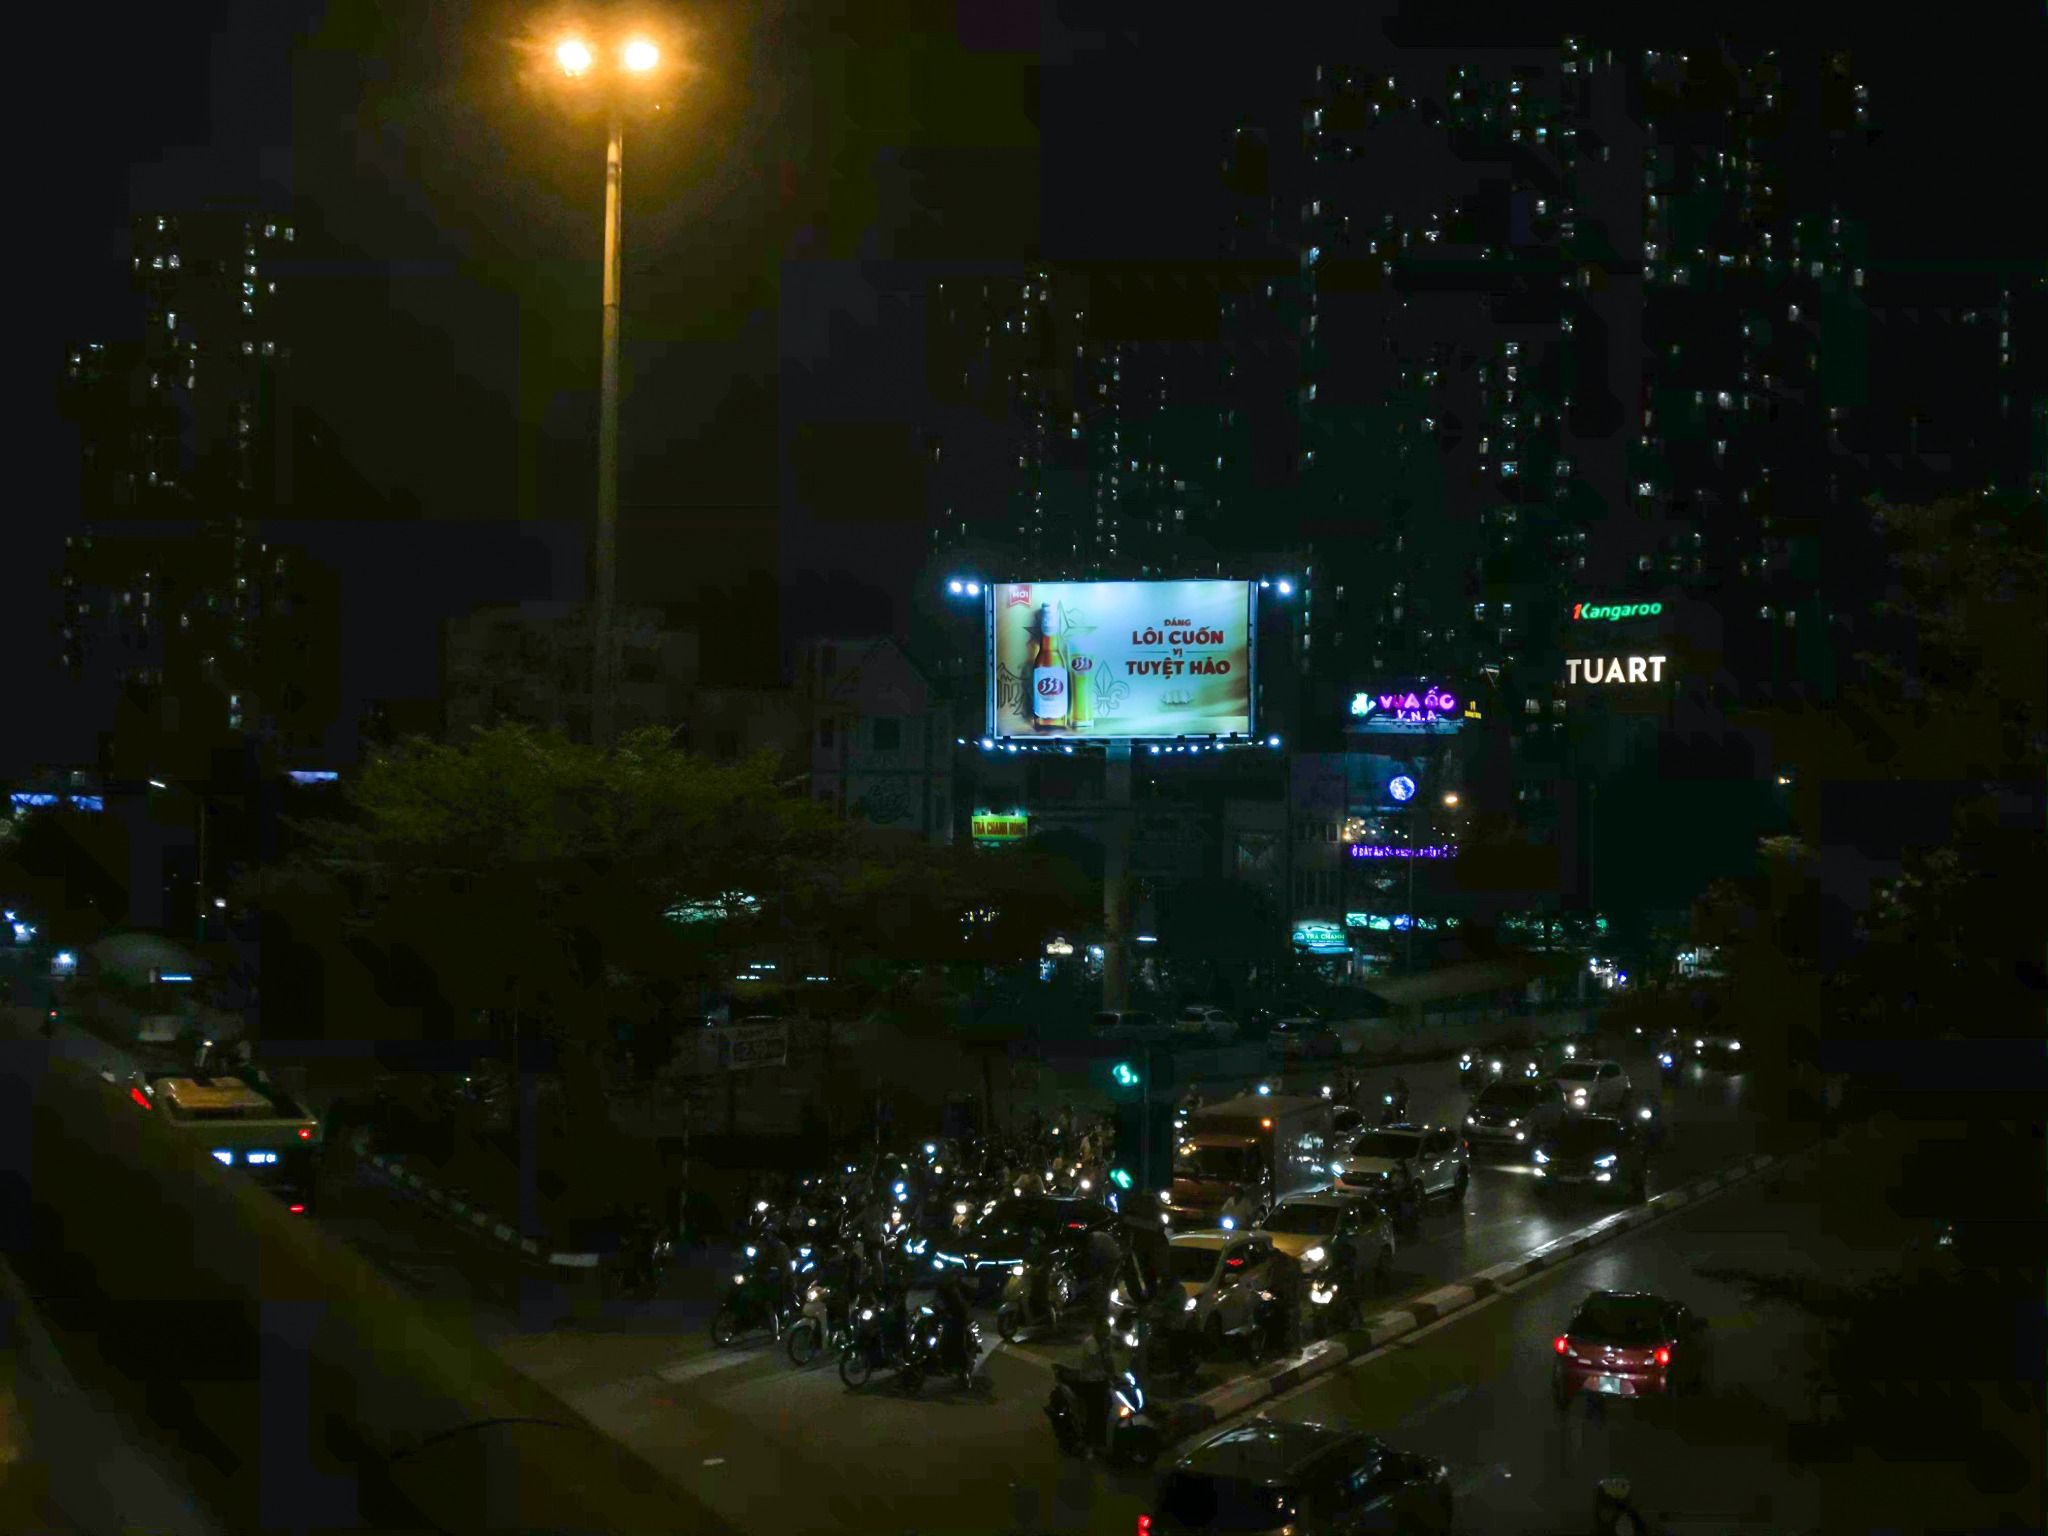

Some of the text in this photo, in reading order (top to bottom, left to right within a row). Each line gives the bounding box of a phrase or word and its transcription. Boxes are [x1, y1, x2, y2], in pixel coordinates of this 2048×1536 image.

[1573, 602, 1662, 621] Kangaroo
[1132, 626, 1224, 645] LÔI CUỐN
[1126, 656, 1231, 680] TUYỆT HẢO
[1566, 656, 1666, 684] TUART
